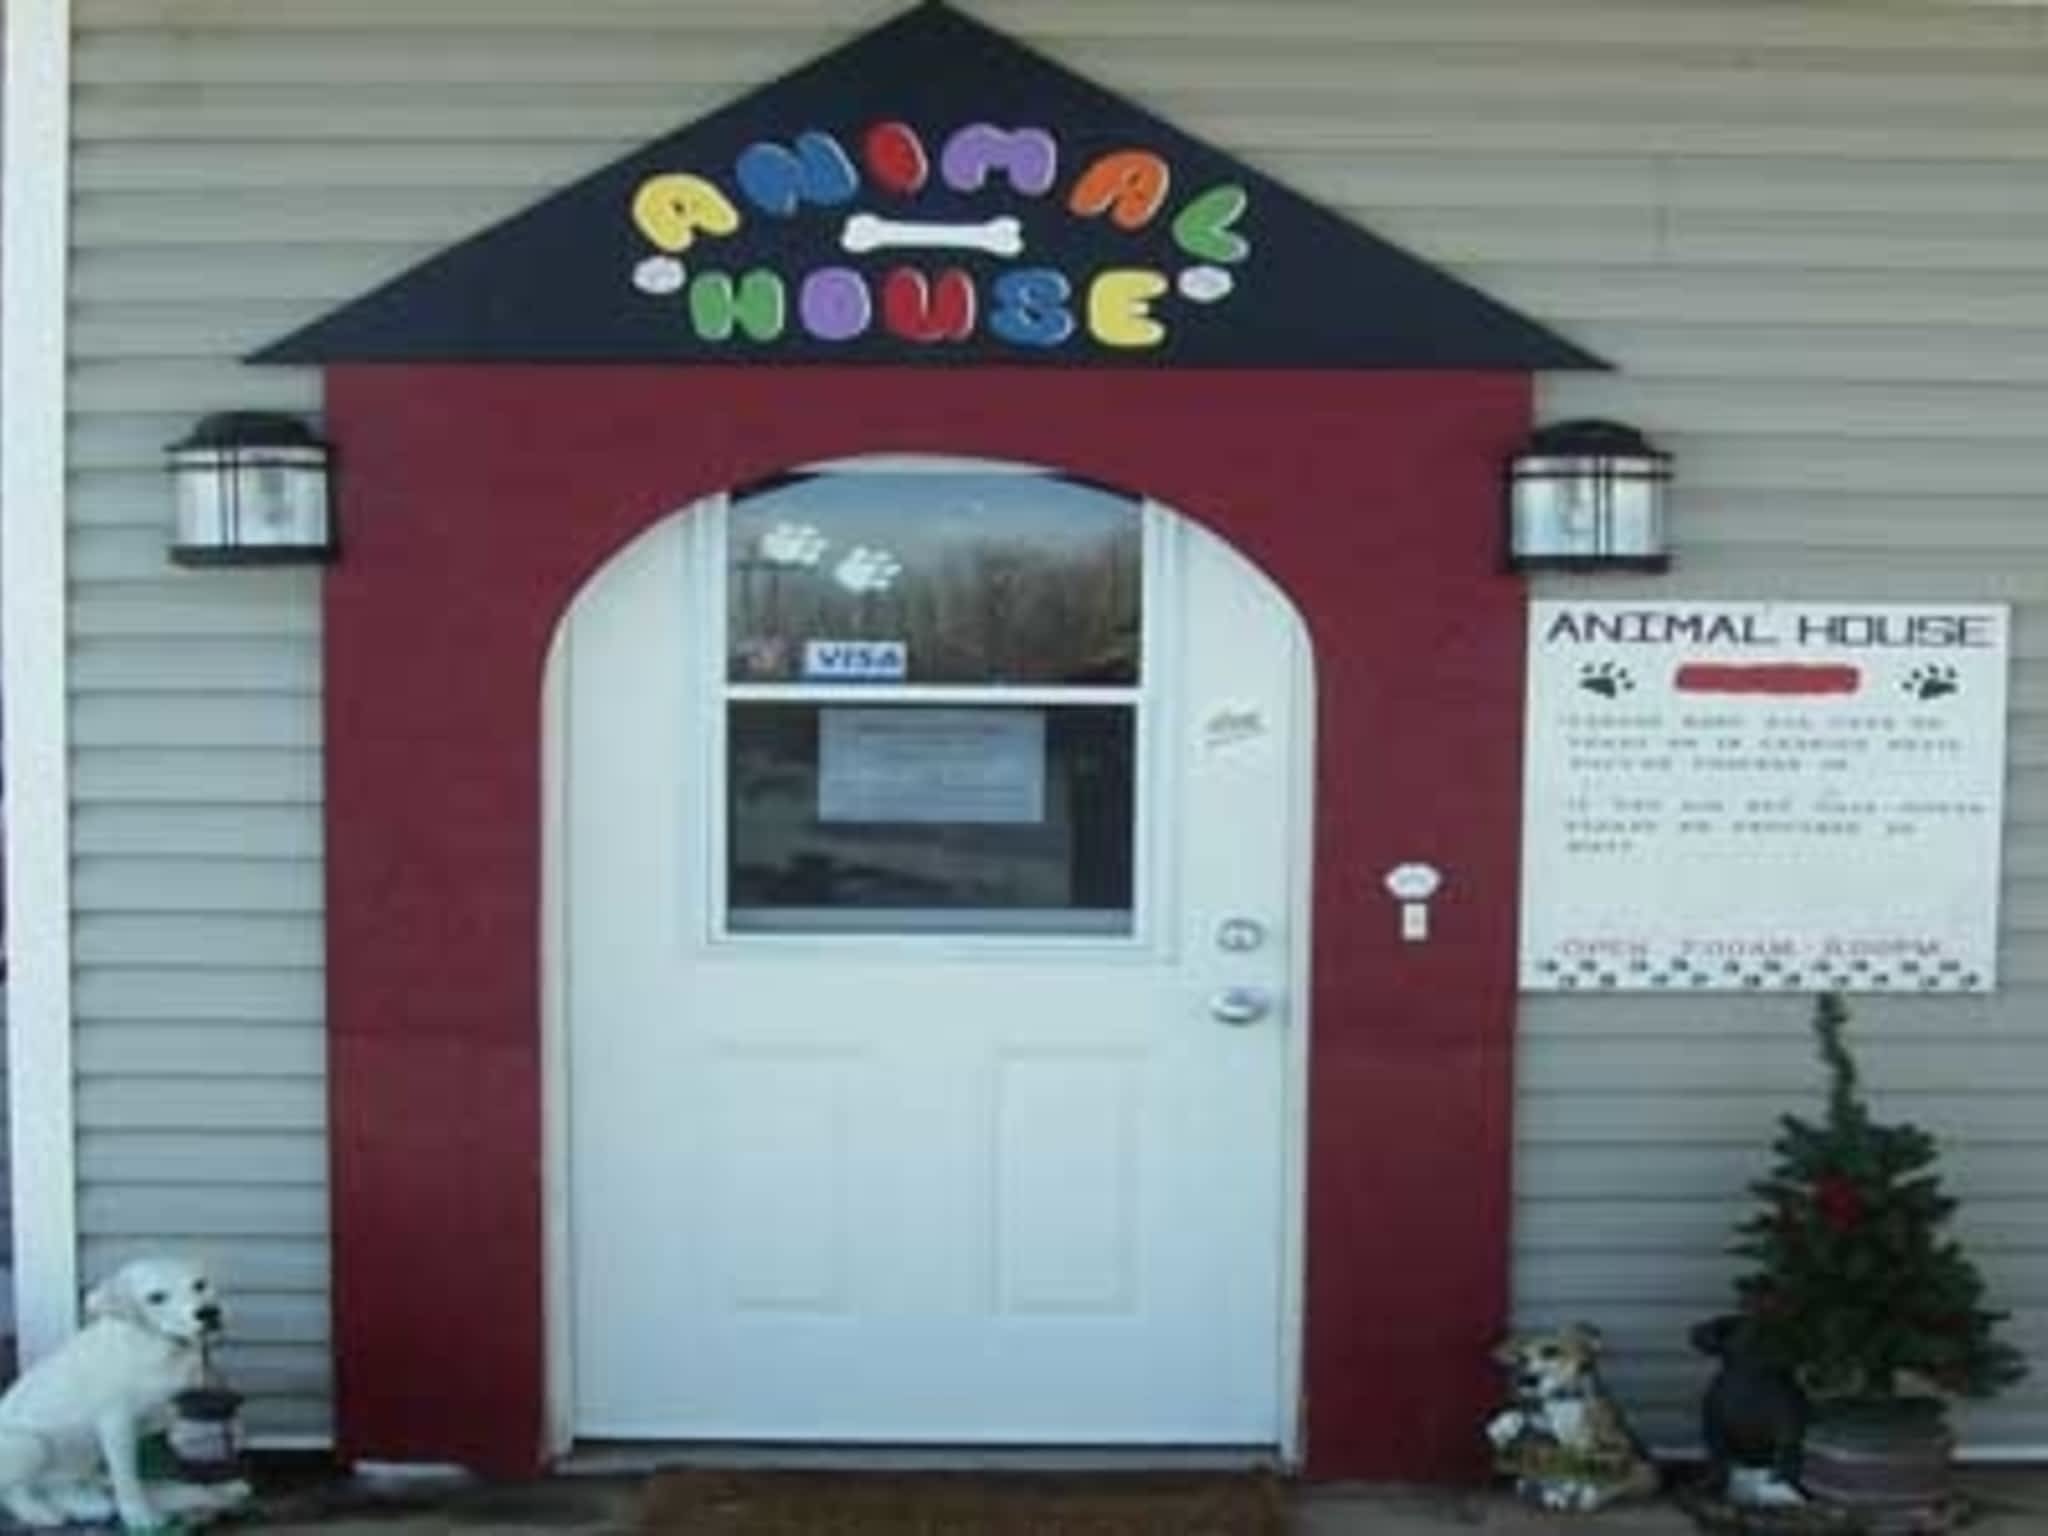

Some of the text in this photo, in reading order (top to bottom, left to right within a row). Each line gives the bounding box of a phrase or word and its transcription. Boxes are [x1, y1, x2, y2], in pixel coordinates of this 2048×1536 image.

[632, 121, 1249, 263] ANIMAL
[690, 267, 1168, 348] HOUSE
[817, 648, 898, 669] VISA
[1547, 611, 1996, 649] ANIMAL HOUSE
